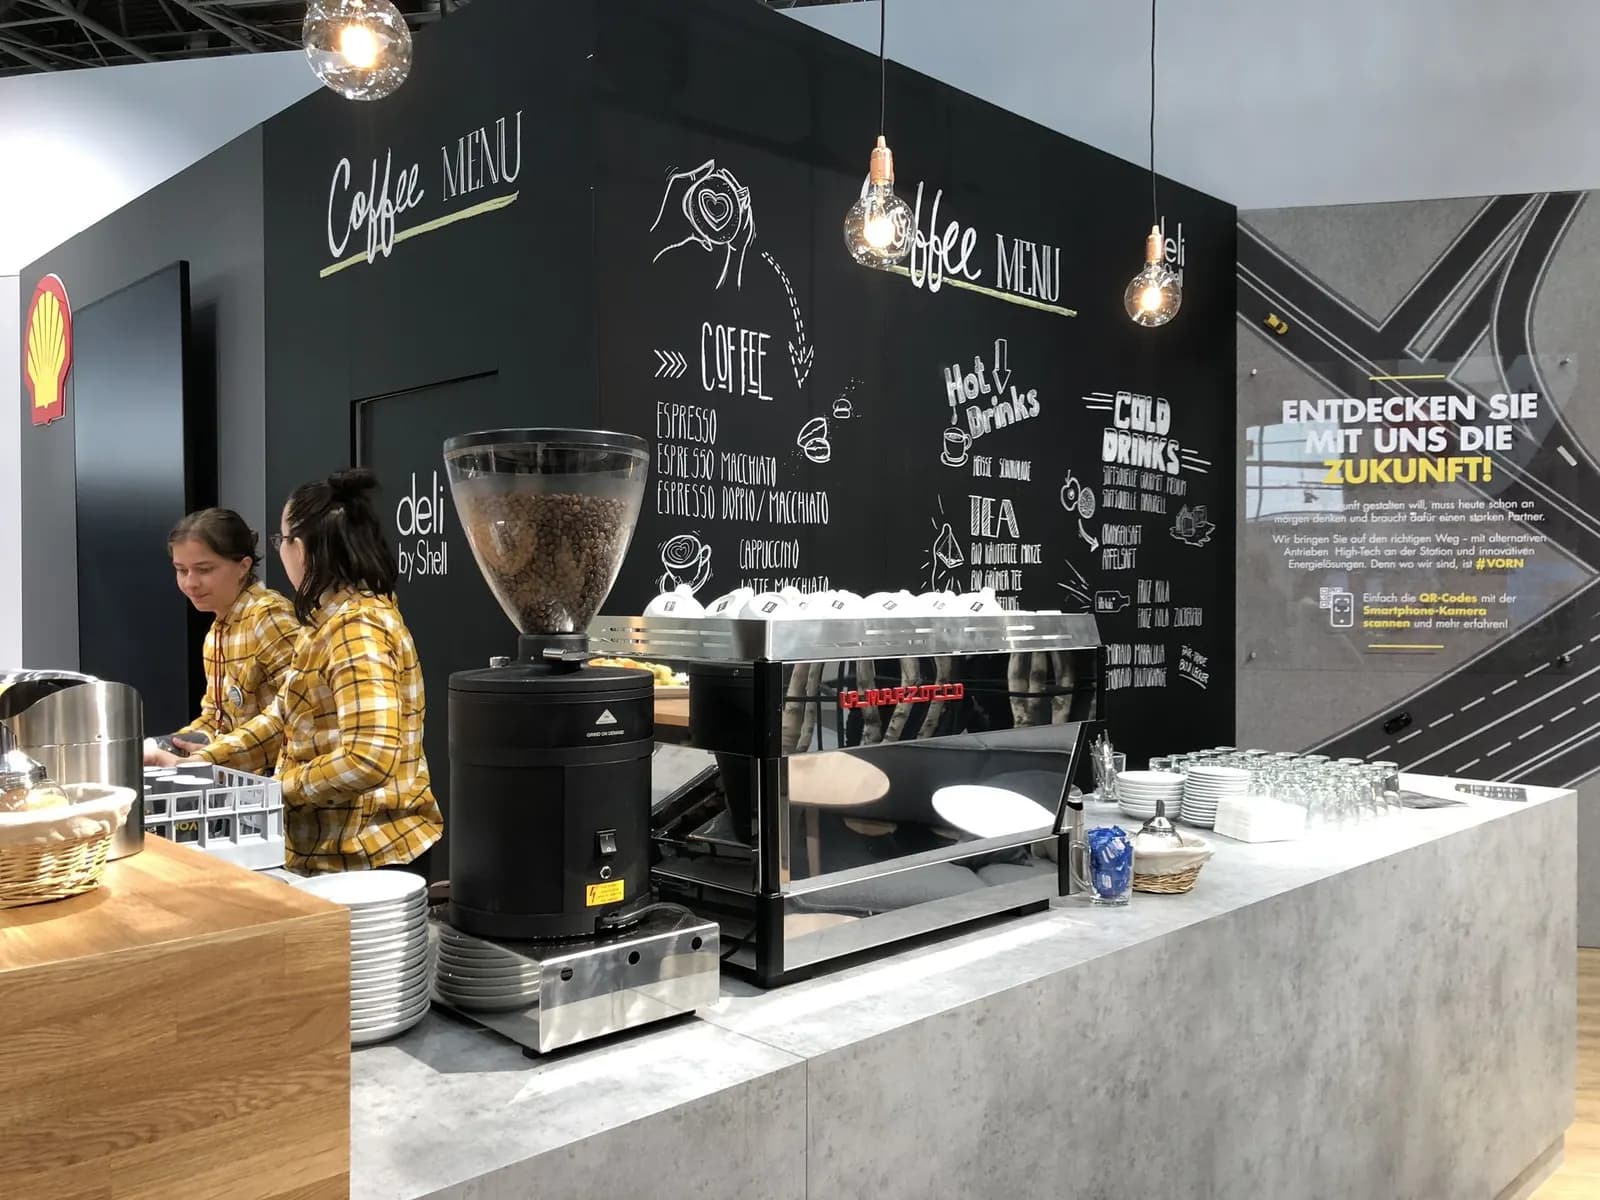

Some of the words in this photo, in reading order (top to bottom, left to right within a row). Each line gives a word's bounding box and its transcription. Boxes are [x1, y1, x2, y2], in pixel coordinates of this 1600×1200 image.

[327, 148, 425, 265] Coffee
[441, 110, 523, 202] MENU
[1161, 216, 1185, 267] eli
[995, 233, 1061, 302] MENU
[701, 321, 774, 400] COFFEE
[944, 355, 991, 407] Hot
[656, 401, 717, 445] ESPRESSO
[966, 385, 1040, 439] Drinks
[1114, 391, 1171, 436] COLD
[1282, 395, 1476, 424] ENTDECKEN
[1488, 393, 1538, 419] SIE
[1102, 428, 1179, 475] DRINKS
[1305, 428, 1363, 454] MIT
[1374, 426, 1448, 453] UNS
[1460, 425, 1513, 451] DIE
[657, 442, 715, 481] ESPRESSO
[720, 451, 777, 488] MACCHIATO
[1322, 456, 1492, 484] ZUKUNFT!
[396, 470, 443, 535] deli
[657, 480, 715, 520] ESPRESSO
[968, 494, 1020, 538] TEA
[1274, 515, 1309, 525] morgen
[1313, 514, 1347, 523] denken
[1350, 513, 1368, 523] und
[1371, 513, 1407, 523] braucht
[1439, 513, 1466, 522] einen
[1469, 512, 1504, 522] starken
[1363, 500, 1406, 512] gestalten
[1409, 499, 1427, 511] will,
[1458, 499, 1485, 509] heute
[1489, 498, 1518, 509] schon
[1521, 501, 1535, 509] an
[739, 538, 800, 570] CAPPUCCINO
[1272, 534, 1290, 544] Wir
[1294, 534, 1333, 545] bringen
[1333, 534, 1348, 544] Sie
[1350, 534, 1366, 544] auf
[1369, 534, 1388, 544] den
[1391, 534, 1432, 545] richtigen
[1435, 534, 1460, 545] Weg
[1471, 534, 1486, 543] mit
[1489, 533, 1548, 543] alternativen
[1400, 547, 1416, 556] der
[1420, 546, 1453, 556] Station
[1456, 546, 1475, 556] und
[1479, 546, 1535, 556] innovativen
[398, 542, 415, 583] by
[416, 538, 448, 576] Shell
[1371, 559, 1396, 569] Denn
[1399, 561, 1414, 569] wo
[1417, 559, 1433, 569] wir
[1462, 559, 1473, 569] ist
[1363, 592, 1397, 603] Einfach
[1401, 592, 1416, 603] die
[1419, 592, 1478, 603] QR-Codes
[1481, 593, 1496, 603] mit
[1499, 592, 1517, 603] der
[1363, 605, 1488, 617] Smartphone-Kamera
[1363, 620, 1411, 628] scannen
[1414, 618, 1433, 629] und
[1436, 618, 1460, 628] mehr
[1463, 618, 1509, 629] erfahren!
[866, 683, 965, 705] MARZOCCO
